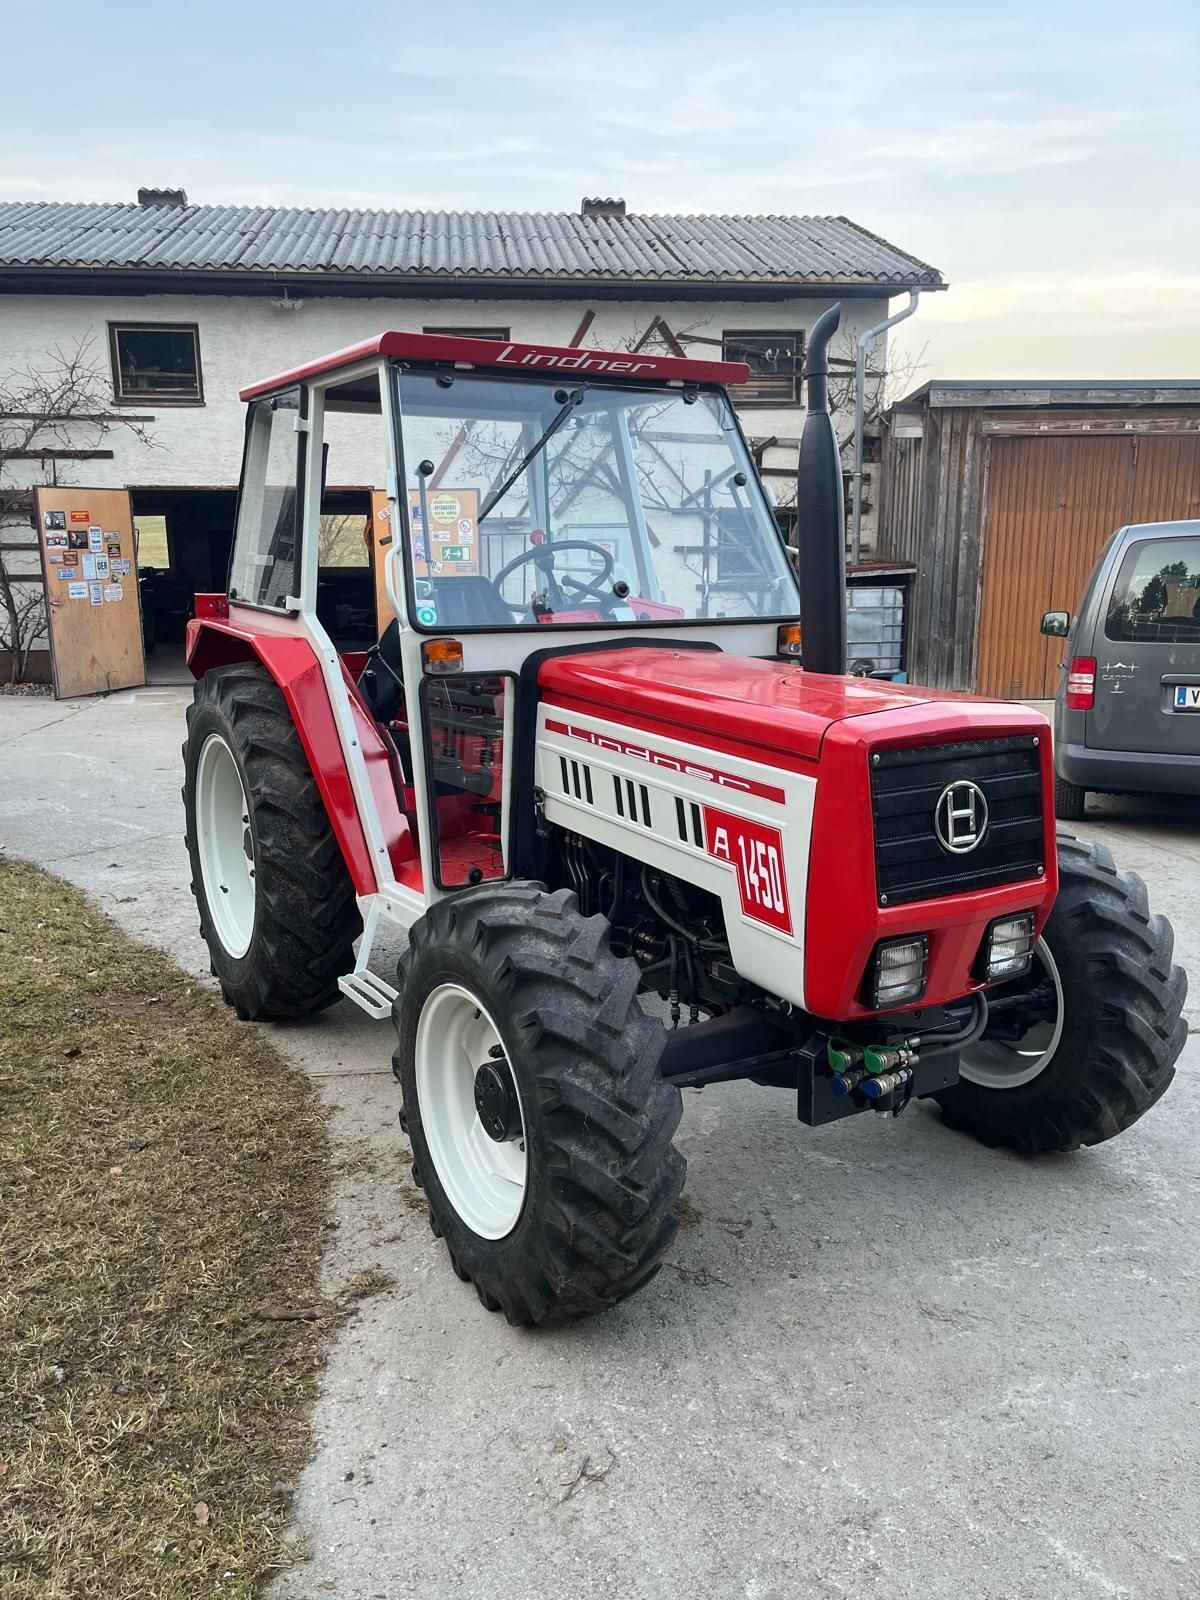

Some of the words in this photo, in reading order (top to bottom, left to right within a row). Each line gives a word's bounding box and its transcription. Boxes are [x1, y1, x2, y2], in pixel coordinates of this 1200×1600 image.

[495, 345, 657, 373] Lindner
[567, 725, 751, 790] Lindner
[713, 826, 730, 859] A
[737, 834, 785, 914] 1450
